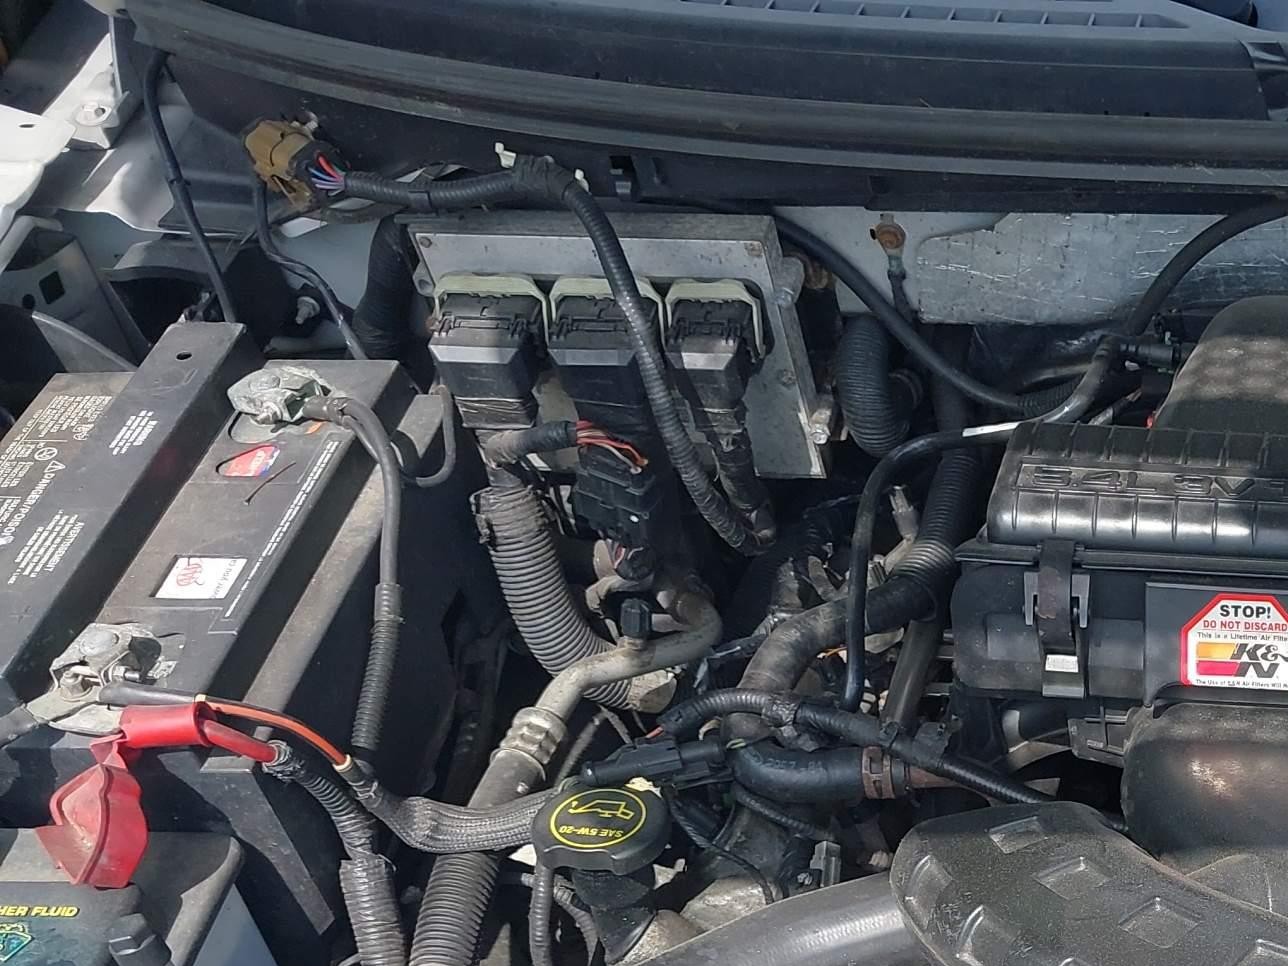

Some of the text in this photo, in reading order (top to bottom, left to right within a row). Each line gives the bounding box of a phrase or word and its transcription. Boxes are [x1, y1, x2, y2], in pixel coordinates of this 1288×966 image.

[1032, 465, 1157, 492] 5.4L
[1173, 474, 1256, 497] 3V
[1219, 604, 1271, 619] STOP!
[1203, 619, 1288, 632] DO NOT DISCARD
[1197, 631, 1212, 639] This
[1230, 633, 1258, 641] Lifetime
[558, 825, 624, 838] SAE 5W-20
[31, 905, 79, 917] FLUID
